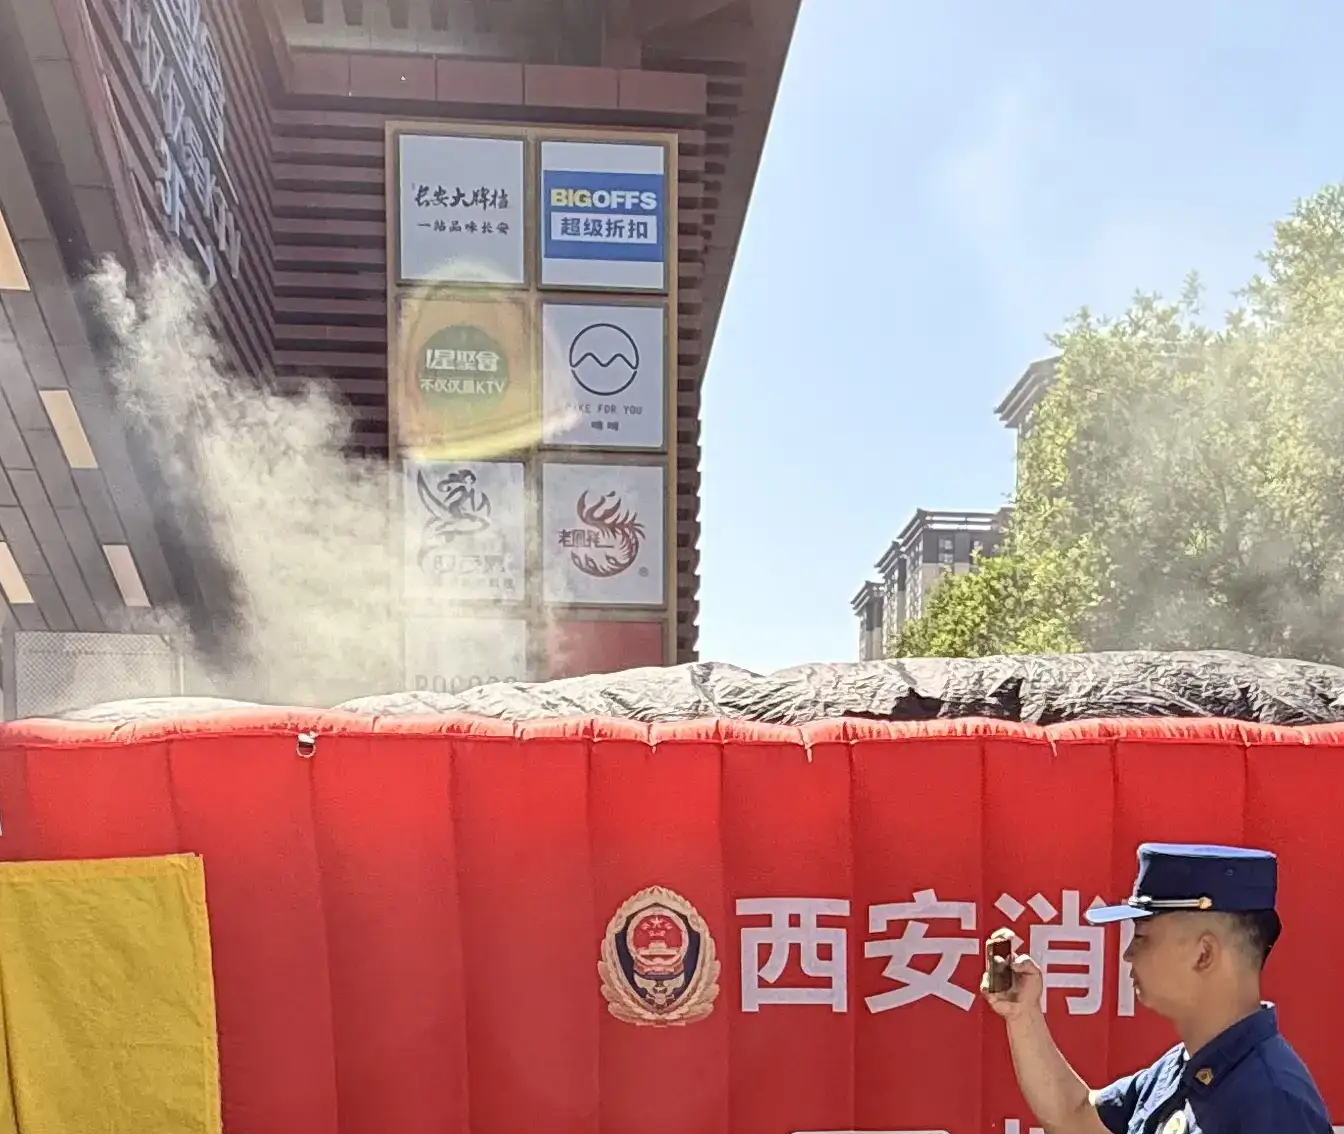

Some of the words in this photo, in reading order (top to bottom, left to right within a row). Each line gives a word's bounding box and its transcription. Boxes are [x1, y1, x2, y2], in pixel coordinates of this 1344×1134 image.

[550, 188, 657, 210] BIGOFFS
[560, 216, 649, 239] 超级折扣
[735, 888, 1136, 1017] 西安消
